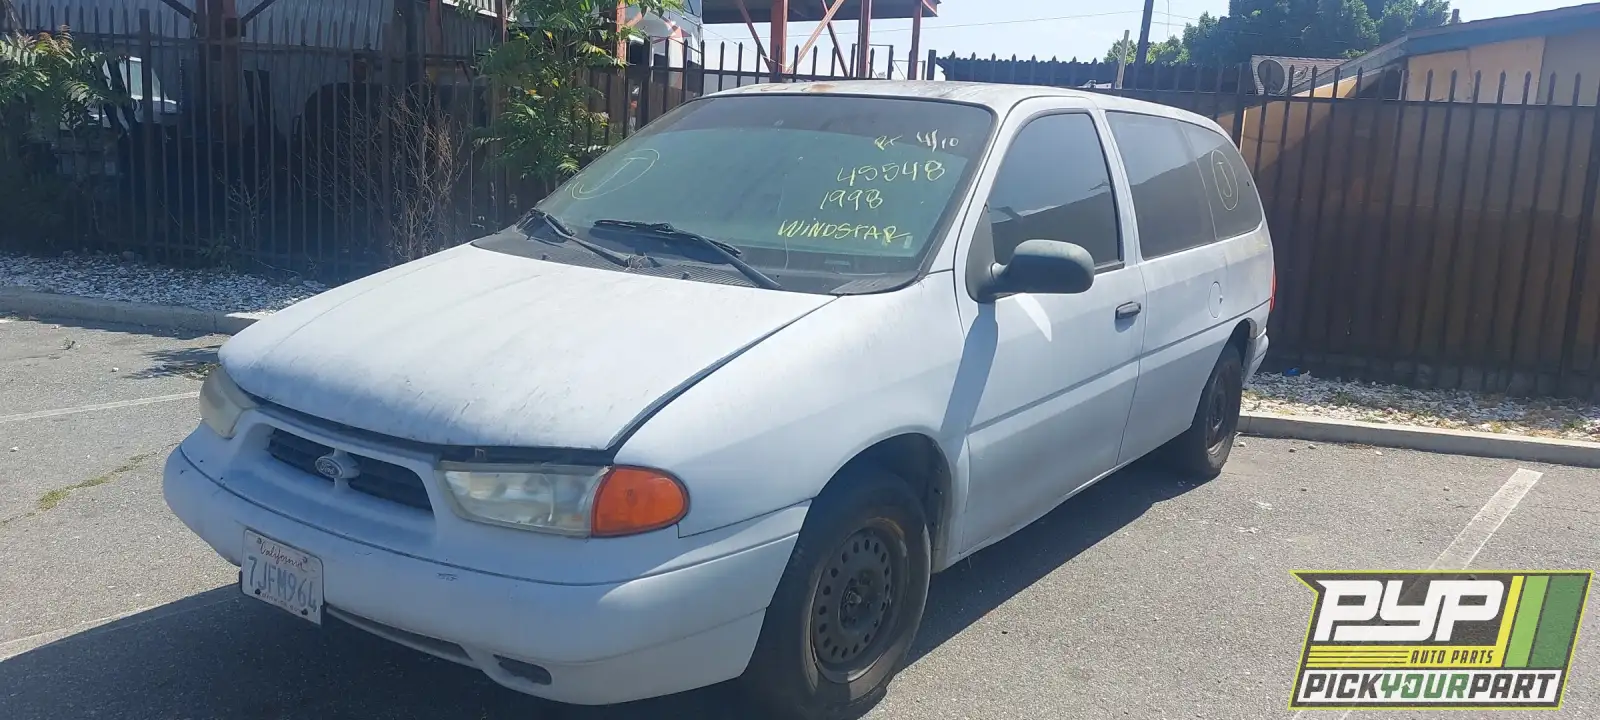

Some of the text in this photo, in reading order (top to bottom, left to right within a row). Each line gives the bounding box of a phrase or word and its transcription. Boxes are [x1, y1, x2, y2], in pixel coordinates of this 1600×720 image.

[916, 129, 960, 152] 4/10
[836, 159, 946, 187] 45548
[819, 188, 884, 211] 1998
[260, 540, 308, 573] California
[248, 554, 318, 613] 7JFM964
